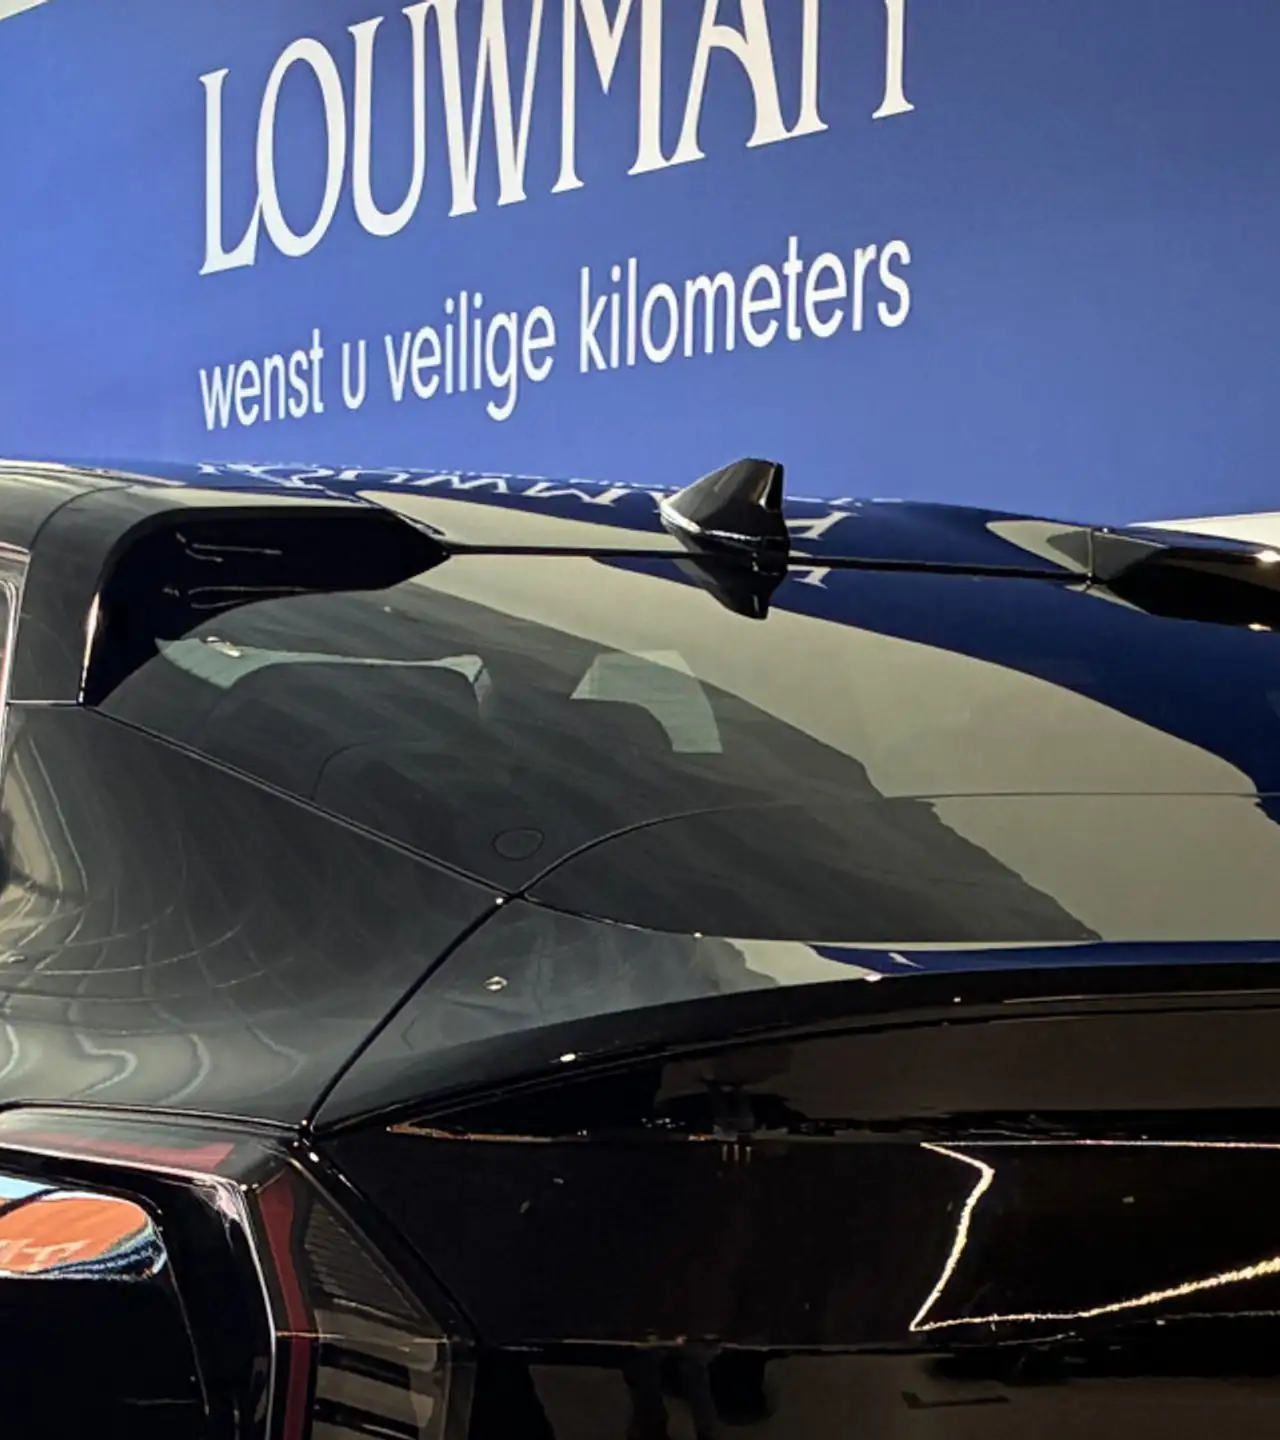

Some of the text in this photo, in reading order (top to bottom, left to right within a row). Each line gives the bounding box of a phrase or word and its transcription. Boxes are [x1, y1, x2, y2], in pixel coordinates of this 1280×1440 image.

[199, 235, 912, 431] wenst u veilige kilometers
